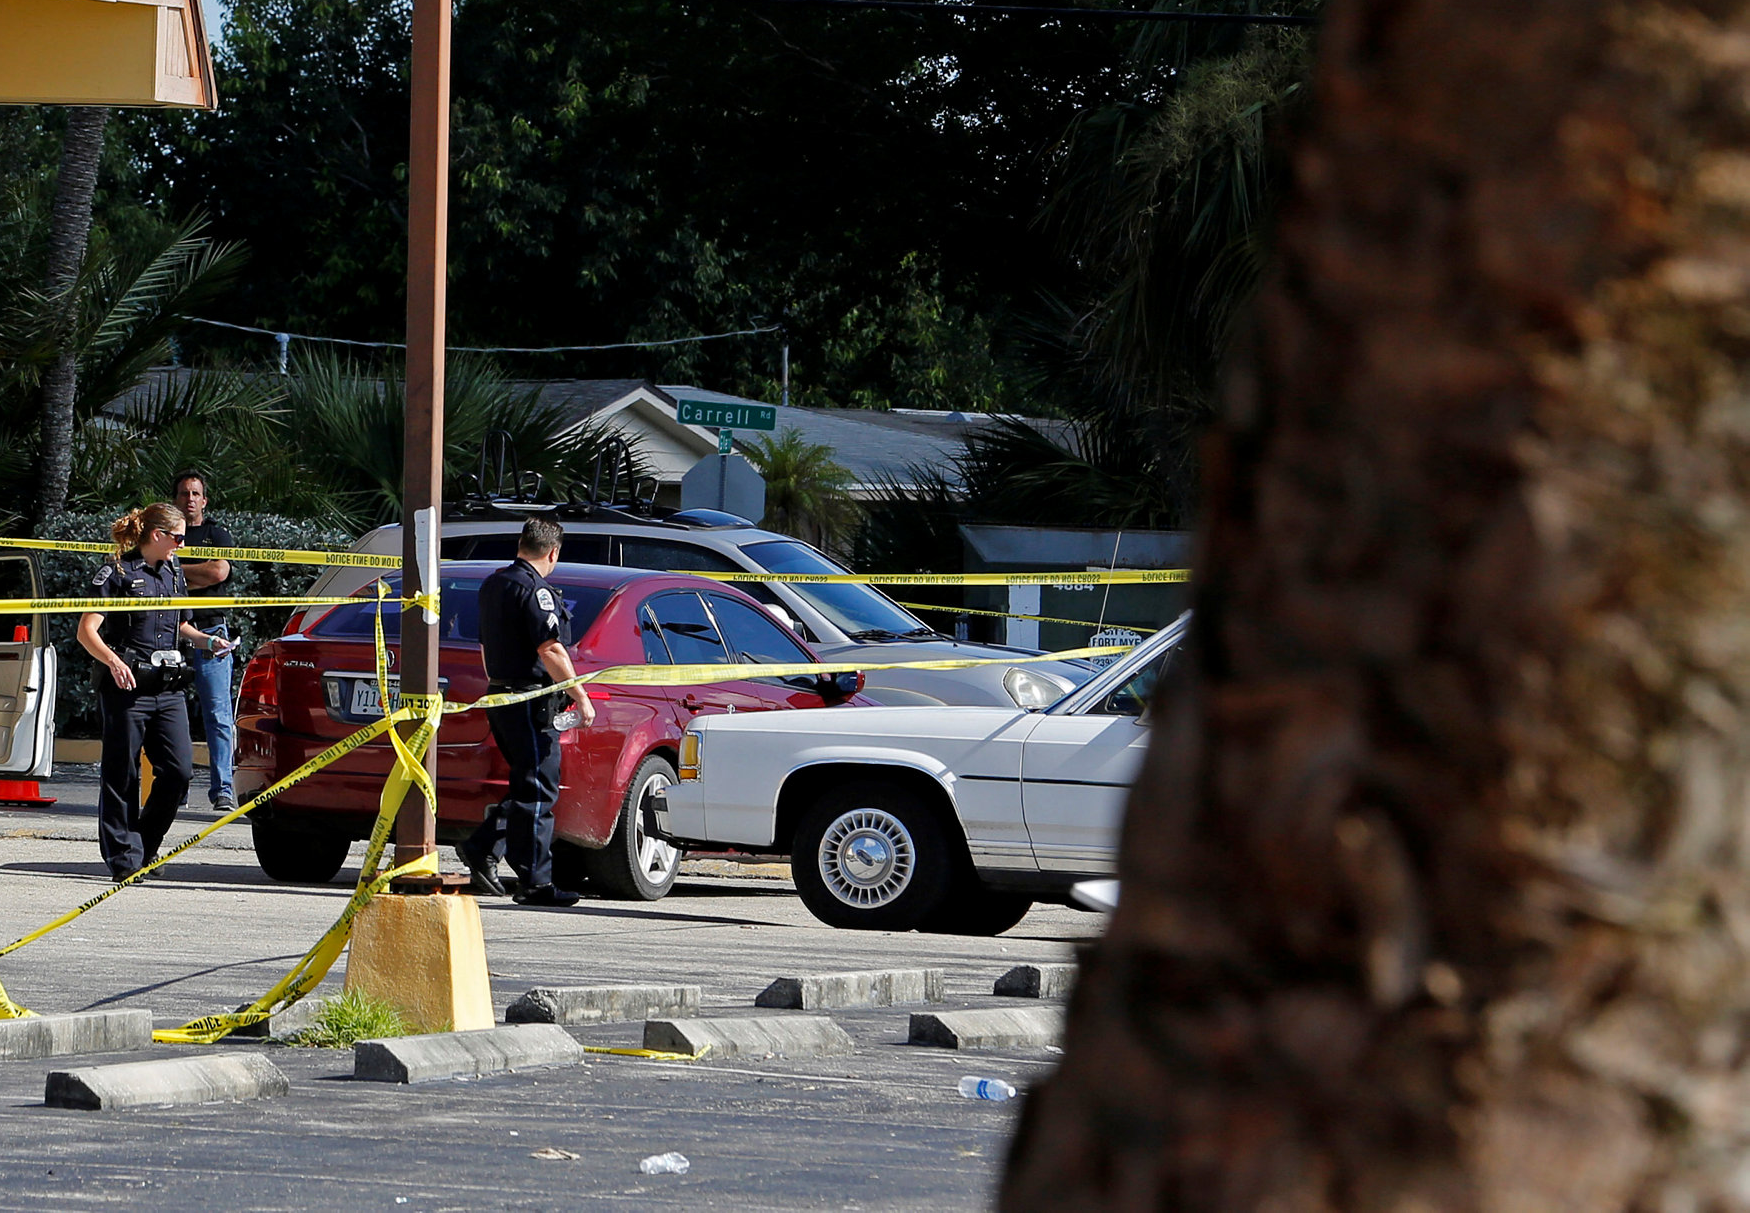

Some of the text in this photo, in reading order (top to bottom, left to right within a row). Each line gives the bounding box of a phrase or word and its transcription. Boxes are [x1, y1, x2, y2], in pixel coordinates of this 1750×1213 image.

[682, 404, 771, 425] Carrell Rd
[1092, 637, 1116, 646] FORT
